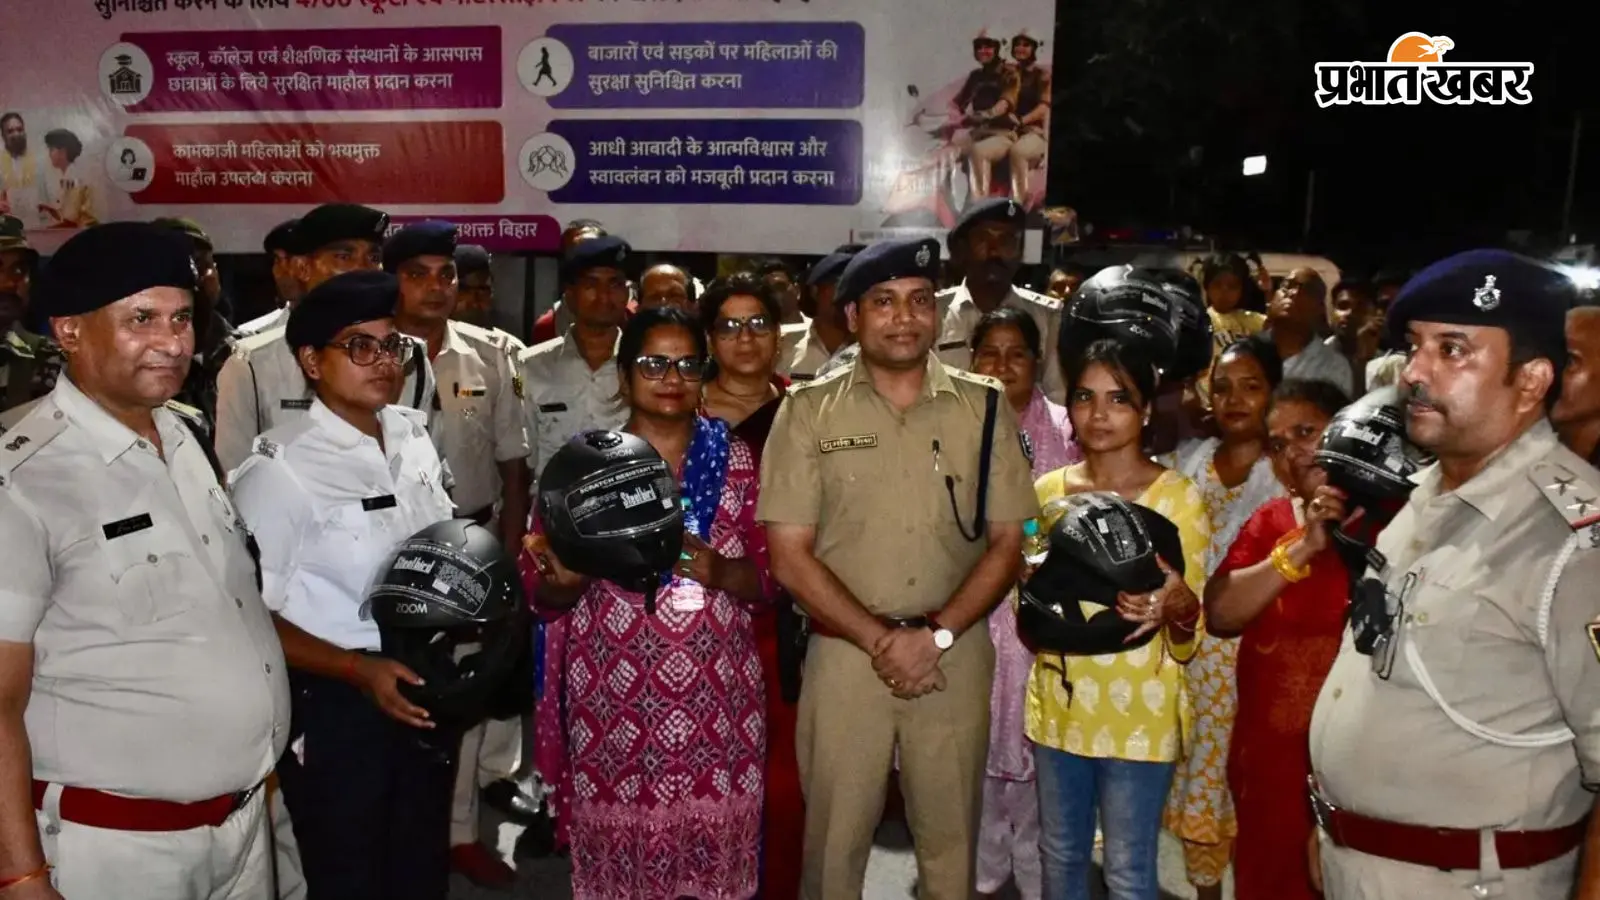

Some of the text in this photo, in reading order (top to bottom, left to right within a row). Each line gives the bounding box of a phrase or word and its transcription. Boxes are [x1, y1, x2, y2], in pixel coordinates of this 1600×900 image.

[166, 42, 483, 70] स्कूल, कॉलेज एवं शैक्षणिक संस्थानों के आसपास
[588, 39, 838, 64] बाजारों एवं सड़कों पर महिलाओं की
[167, 70, 453, 96] छात्राओं के लिये सुरक्षित माहौल प्रदान करना
[588, 71, 743, 95] सुरक्षा सुनिश्चित करना
[172, 138, 381, 165] कामकाजी महिलाओं को भयमुक्त
[588, 136, 828, 158] आधी आबादी के आत्मविश्वास और
[175, 167, 217, 188] माहौल
[271, 170, 313, 187] कराना
[588, 165, 835, 190] स्वावलंबन को मजबूती प्रदान करना
[499, 219, 539, 238] बिहार
[580, 478, 614, 493] SCRATCH
[620, 484, 657, 509] Steelbird
[392, 555, 436, 575] Steelbird
[395, 602, 428, 615] ZOOM
